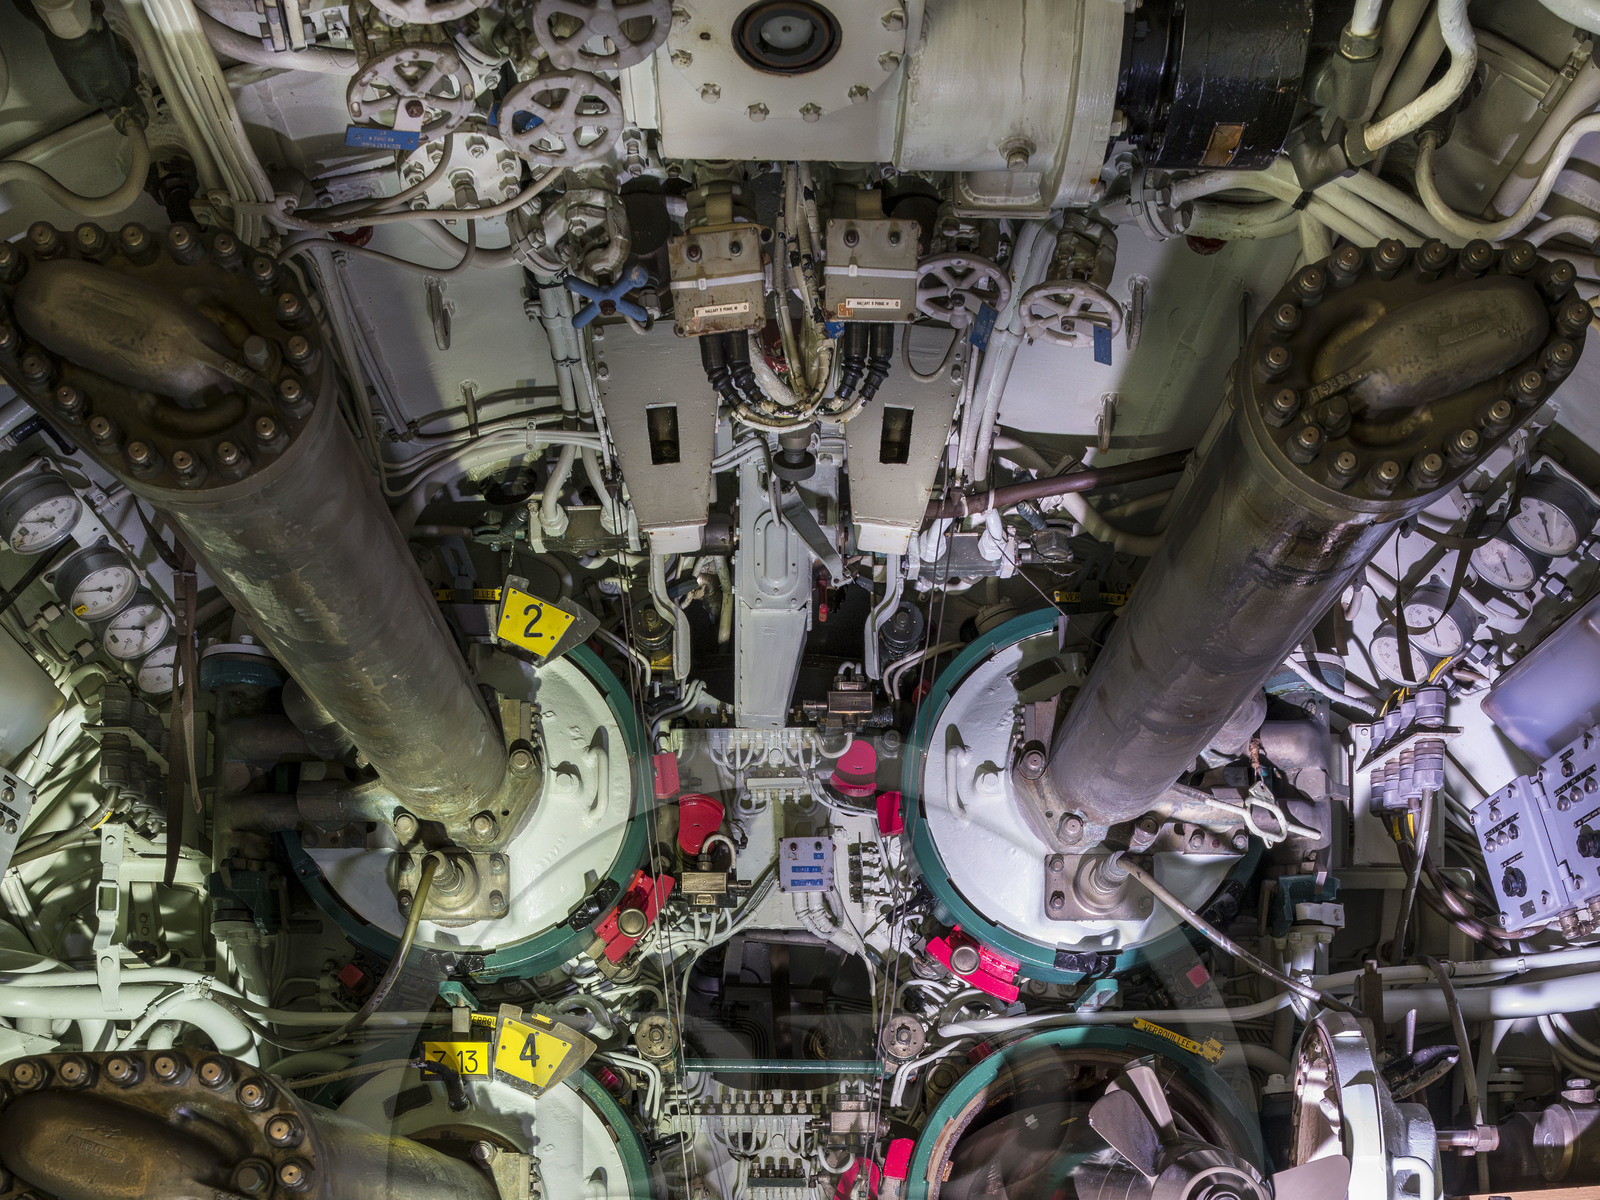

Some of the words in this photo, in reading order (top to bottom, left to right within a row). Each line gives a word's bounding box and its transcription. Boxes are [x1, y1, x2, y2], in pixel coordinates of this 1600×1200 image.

[523, 604, 543, 638] 2
[456, 1050, 478, 1073] 13
[519, 1032, 540, 1067] 4
